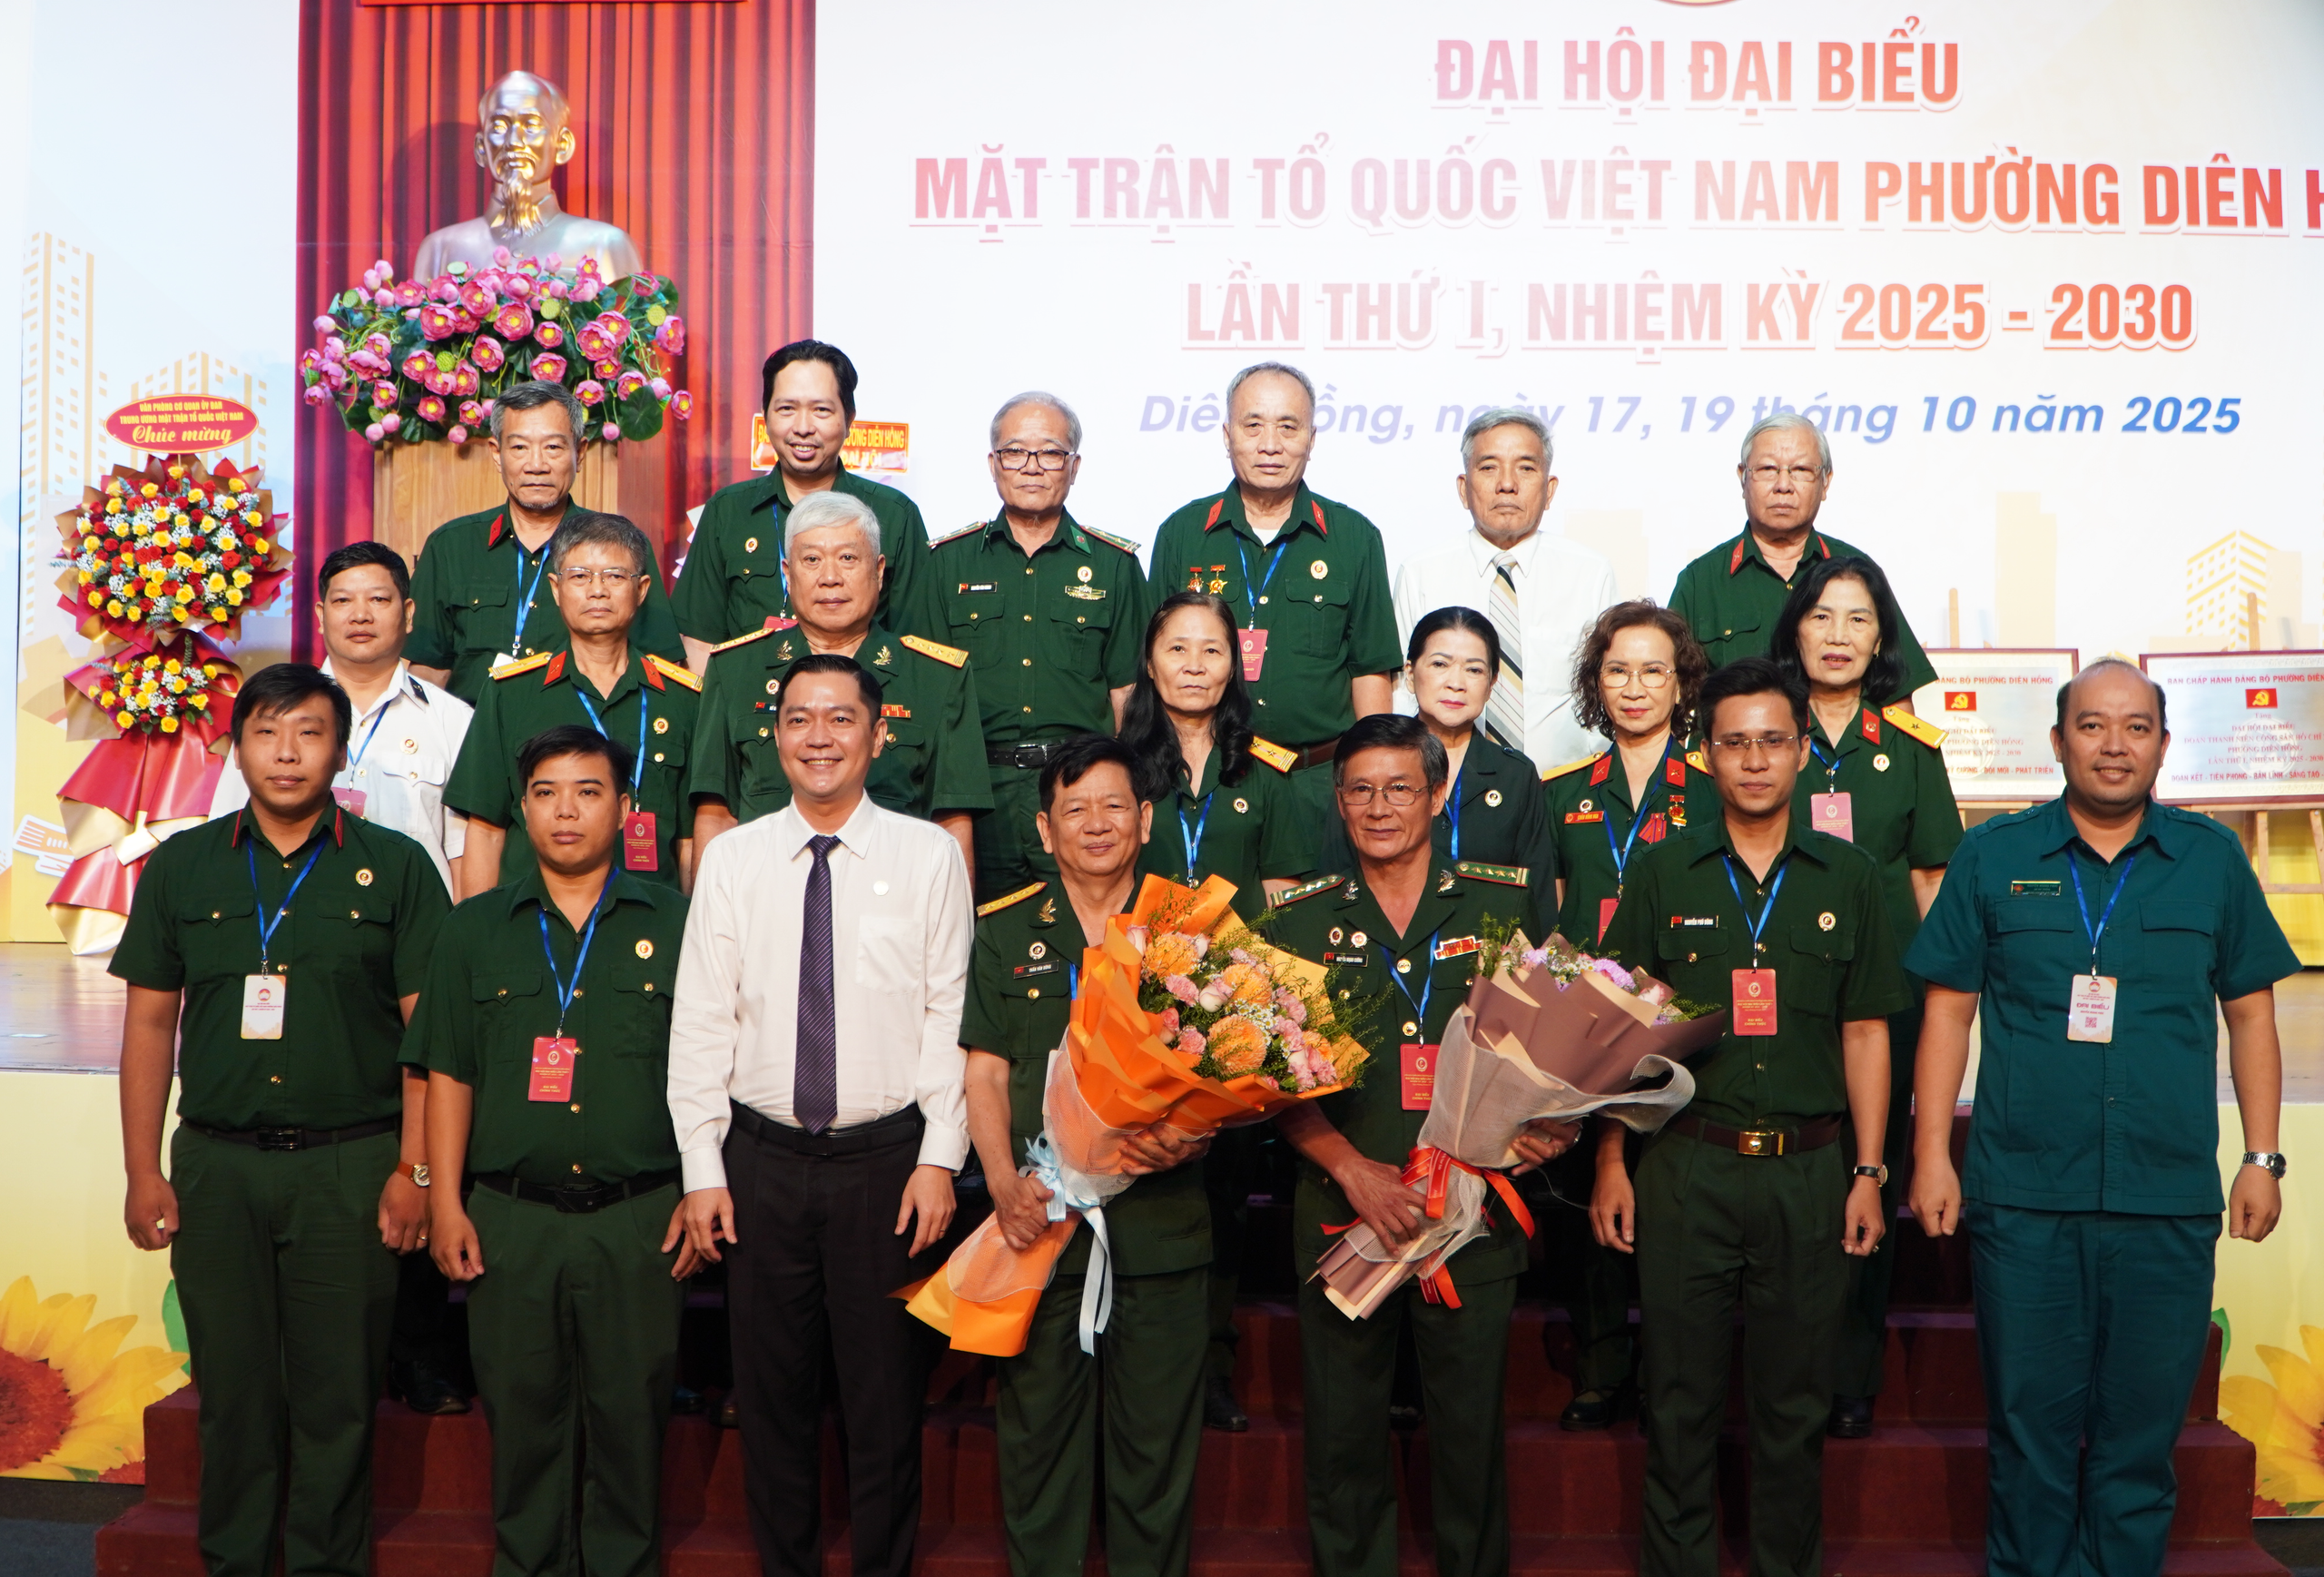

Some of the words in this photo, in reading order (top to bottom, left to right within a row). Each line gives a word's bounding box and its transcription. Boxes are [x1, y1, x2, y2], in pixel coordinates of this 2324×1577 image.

[1434, 39, 1539, 115] ĐẠI
[1564, 26, 1666, 115] HỘI
[1689, 41, 1792, 116] ĐẠI
[1819, 15, 1960, 103] BIỂU
[914, 143, 1047, 233] MẶT
[1068, 144, 1230, 233] TRẬN
[1254, 133, 1329, 221] TỔ
[1351, 136, 1518, 229] QUỐC
[1541, 145, 1671, 234] VIỆT
[1696, 161, 1839, 222] NAM
[1865, 145, 2119, 225] PHƯỜNG
[2143, 153, 2284, 229] DIÊN
[1187, 260, 1301, 342] LẦN
[1322, 269, 1440, 343] THỨ
[1467, 281, 1504, 352] I,
[1528, 271, 1722, 355] NHIỆM
[1748, 269, 1819, 341] KỲ
[1842, 283, 1986, 342] 2025
[2050, 283, 2193, 343] 2030
[120, 416, 139, 424] TRUNG
[229, 412, 243, 420] NAM
[1139, 393, 1221, 433] Diê
[1315, 383, 1414, 445] ồng,
[1587, 396, 1651, 440] 17,
[1680, 395, 1736, 433] 19
[1922, 395, 1977, 433] 10
[1992, 394, 2105, 433] năm
[2122, 396, 2241, 434] 2025
[133, 425, 176, 443] Chúc
[182, 426, 232, 444] mừng
[868, 425, 883, 447] DIÊN
[1974, 675, 2006, 685] PHƯỜNG
[2273, 675, 2305, 683] PHƯỜNG
